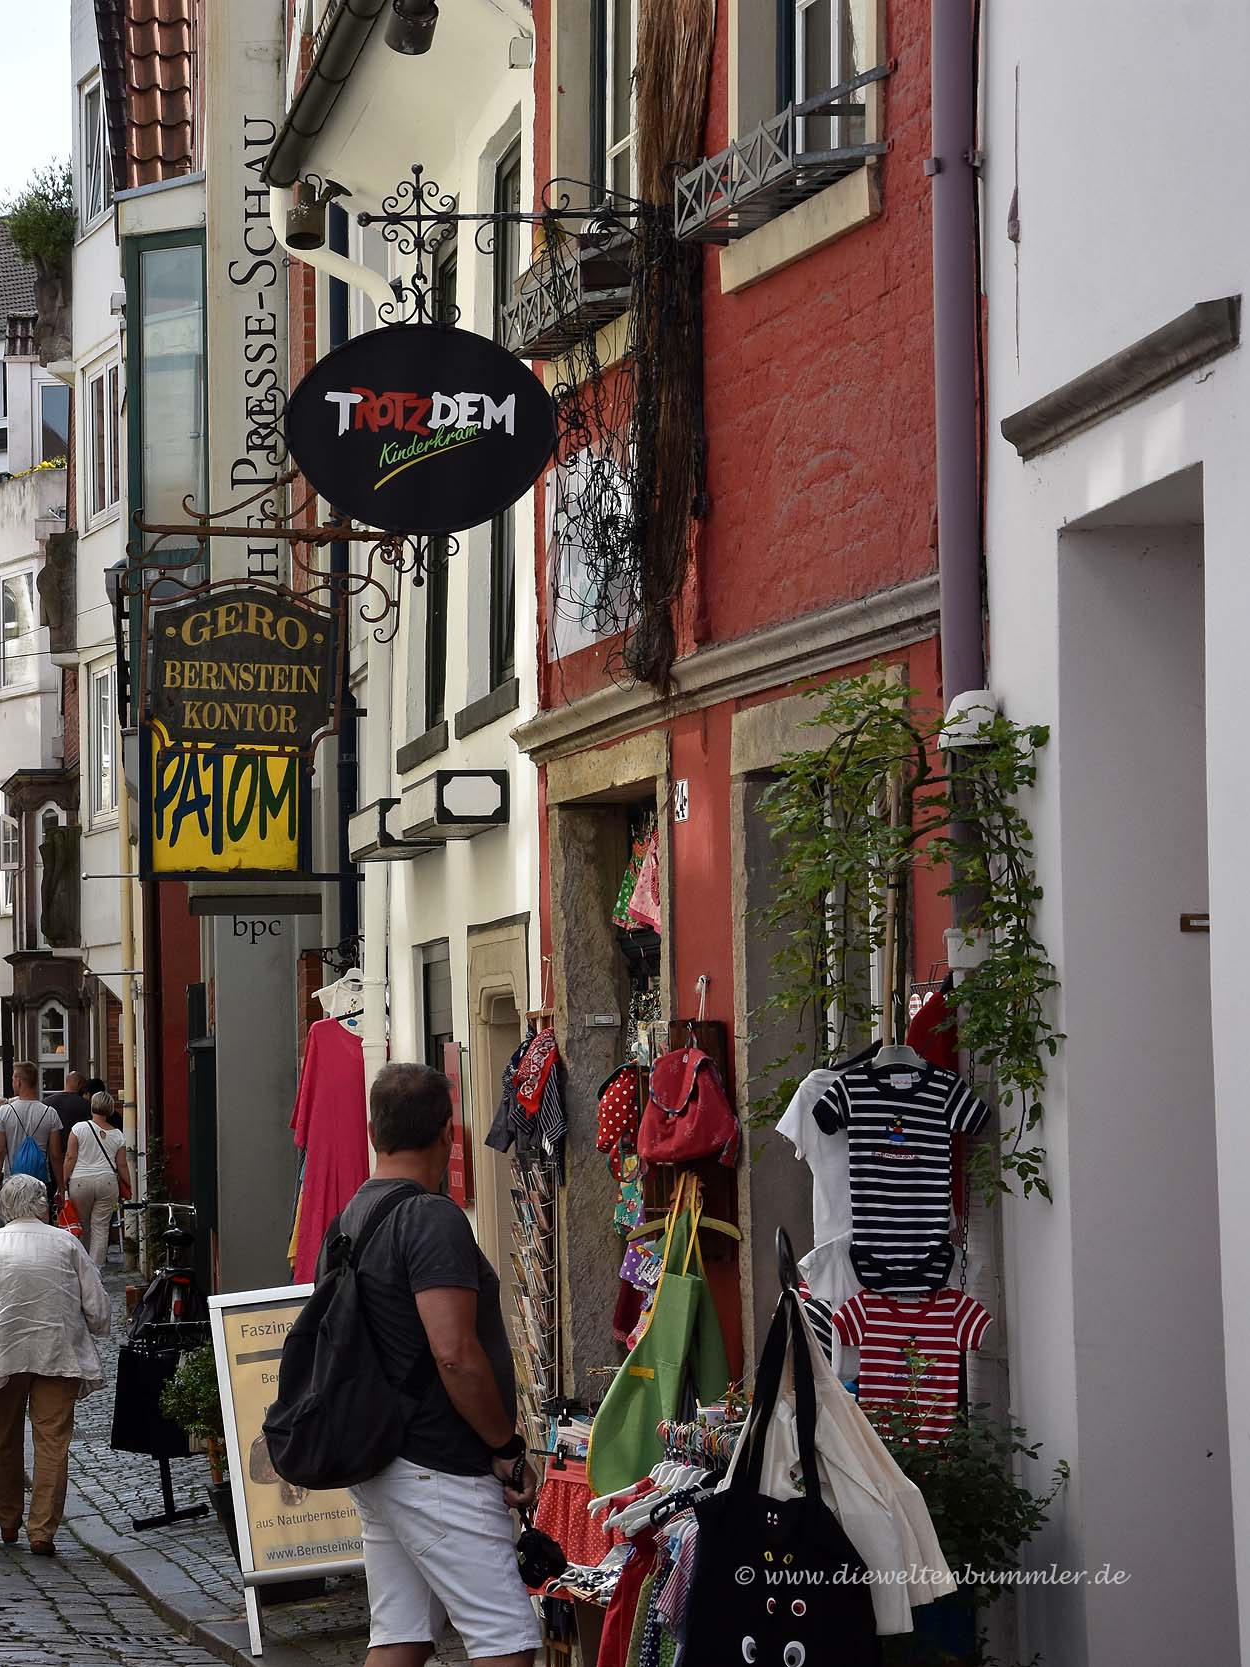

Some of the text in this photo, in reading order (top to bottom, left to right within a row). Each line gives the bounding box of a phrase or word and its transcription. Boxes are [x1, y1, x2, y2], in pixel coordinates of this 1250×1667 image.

[324, 387, 516, 437] TROTZDEM
[379, 424, 479, 468] Kinderkram
[181, 602, 308, 650] GERO
[163, 660, 322, 694] BERNSTEIN
[182, 700, 298, 734] KONTOR
[154, 742, 300, 855] PATOM
[233, 915, 282, 944] bpc
[241, 1321, 294, 1338] Faszina
[261, 1373, 279, 1384] Ber
[256, 1508, 356, 1529] aus Naturbernstein
